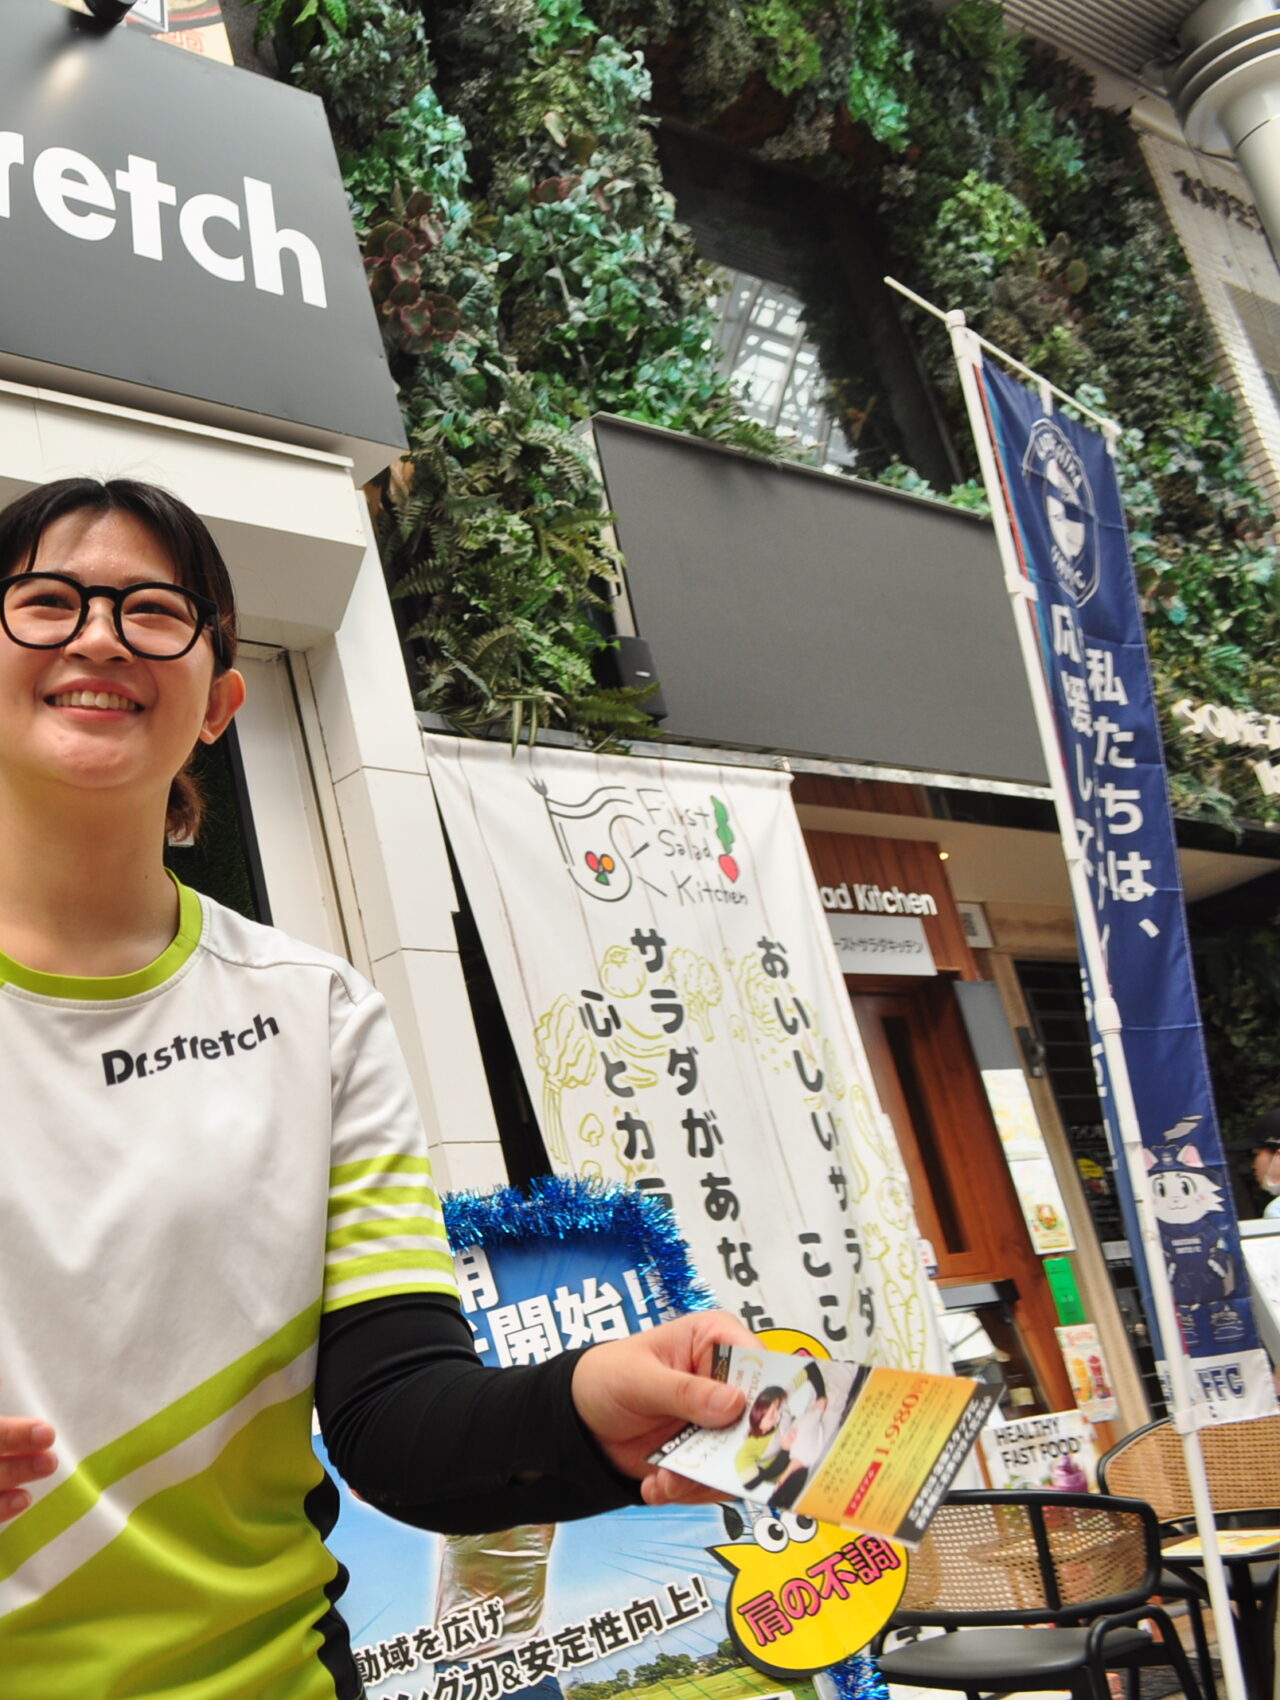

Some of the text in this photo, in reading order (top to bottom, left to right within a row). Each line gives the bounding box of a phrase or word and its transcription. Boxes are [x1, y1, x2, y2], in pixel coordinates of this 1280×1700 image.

[1086, 648, 1159, 938] 私たちは、
[658, 829, 713, 861] Salad
[671, 870, 748, 906] Kitchen
[853, 883, 938, 916] Kitchen
[101, 1013, 280, 1087] Dr.stretch
[994, 1416, 1061, 1446] HEALTHY
[1001, 1434, 1082, 1470] FAST FOOD
[736, 1534, 902, 1647] 肩の不調
